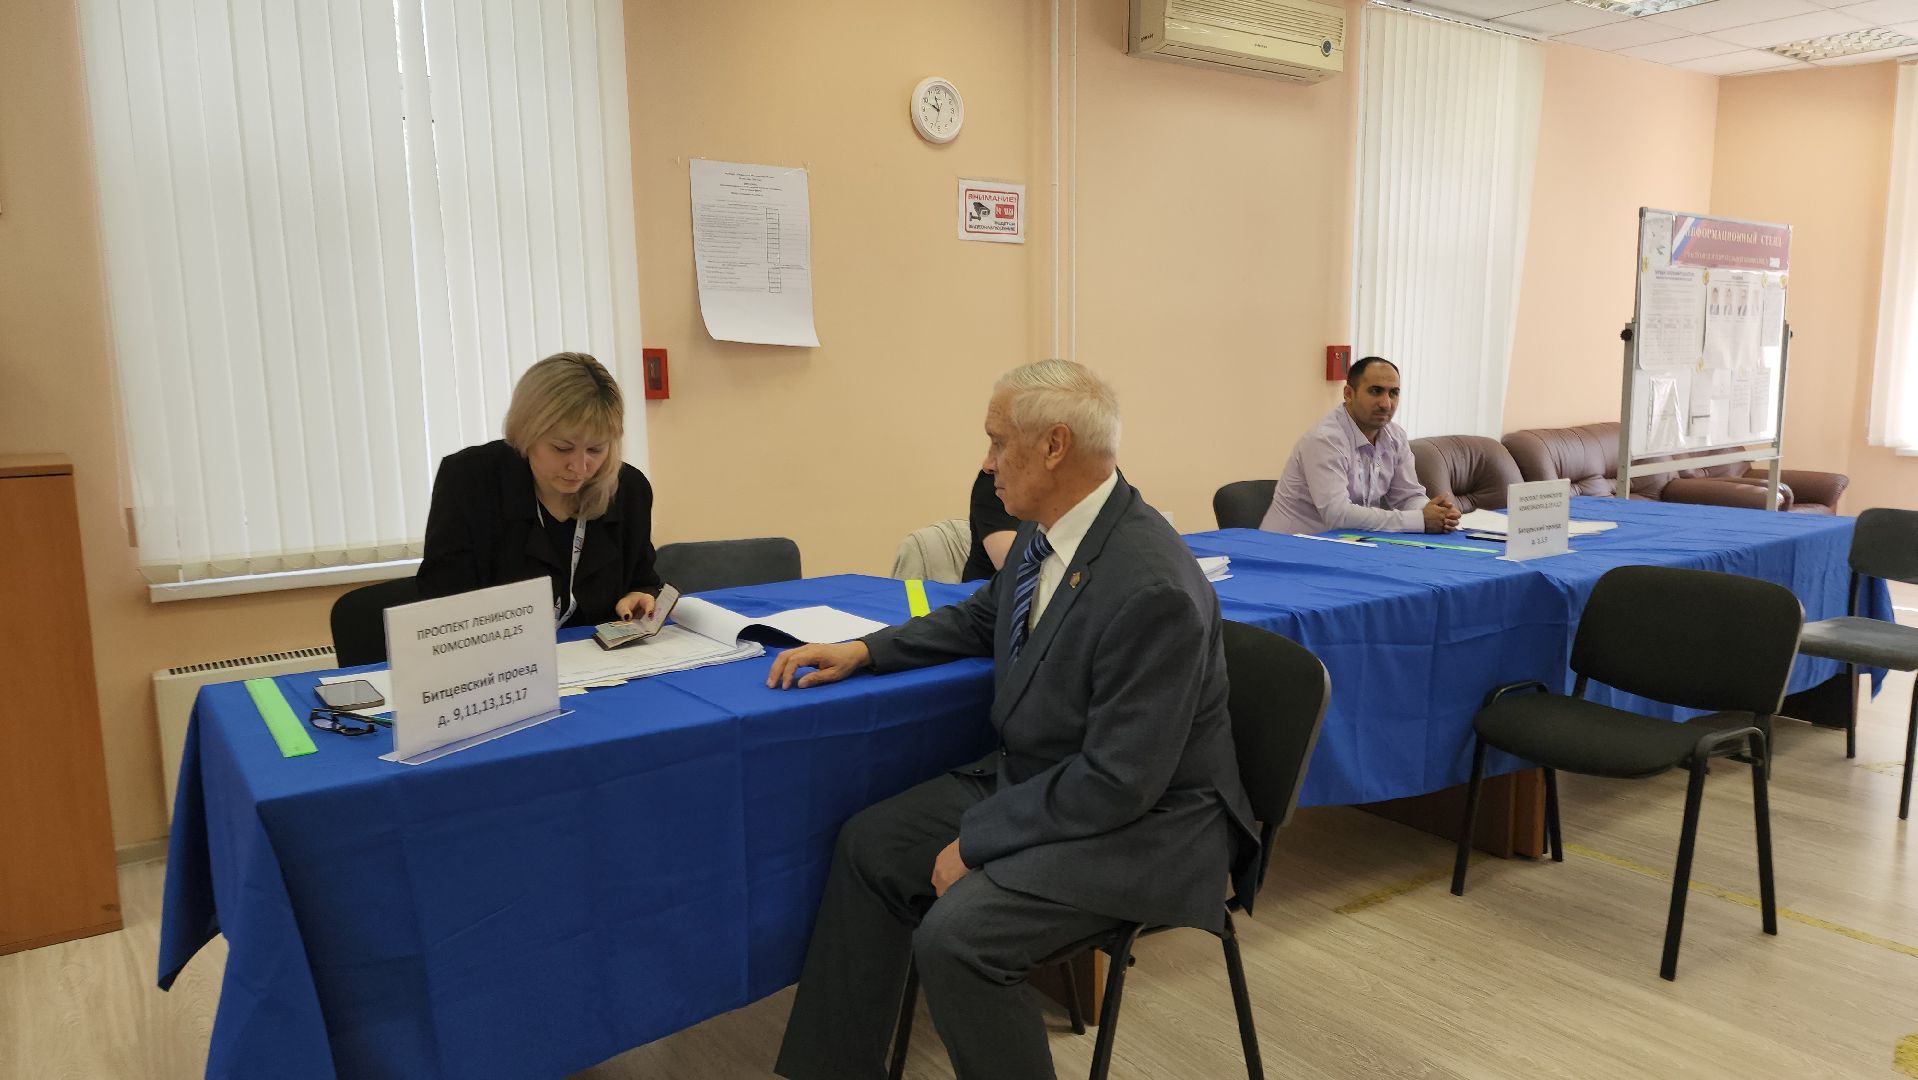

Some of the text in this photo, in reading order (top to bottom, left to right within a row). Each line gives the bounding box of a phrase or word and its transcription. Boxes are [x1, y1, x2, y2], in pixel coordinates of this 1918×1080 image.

[417, 605, 534, 641] ПРОСПЕКТ ЛЕНИНСКОГО
[432, 624, 524, 656] КОМСОМОЛА Д.25
[422, 663, 538, 705] Битцевский проезд
[437, 688, 528, 728] д. 9,11,13,15,17
